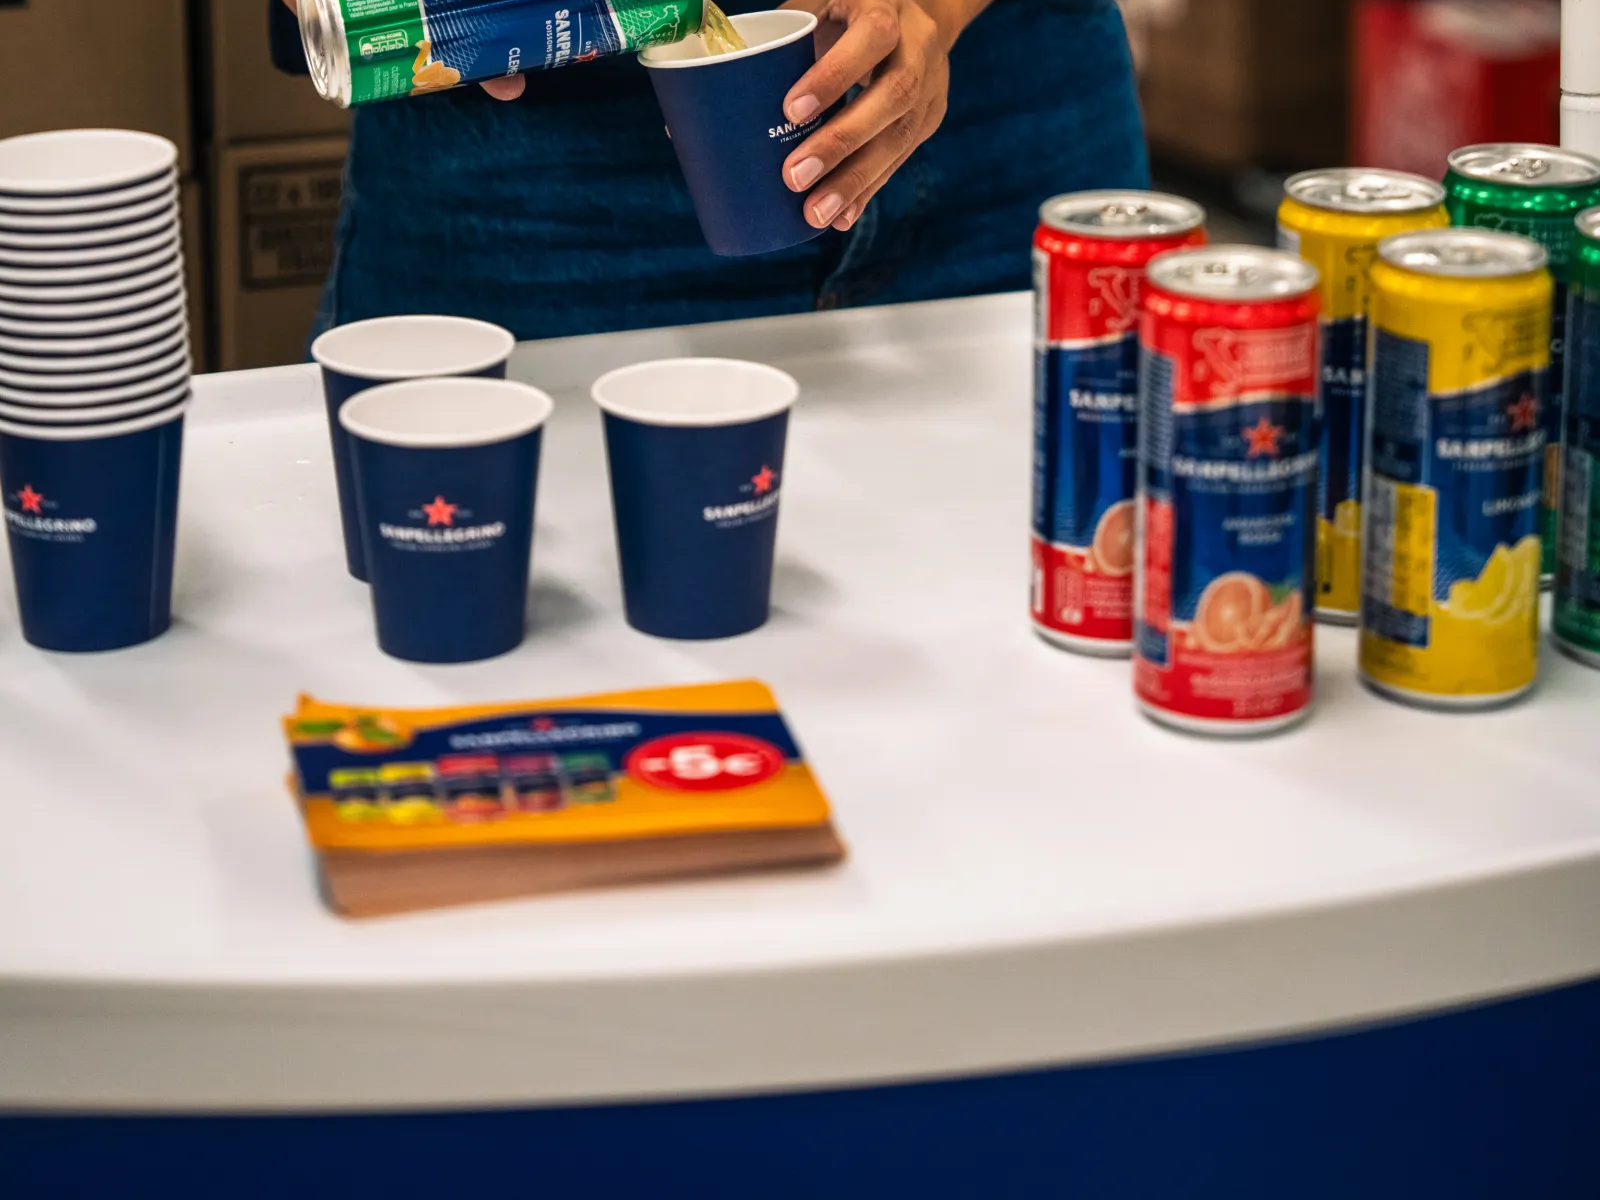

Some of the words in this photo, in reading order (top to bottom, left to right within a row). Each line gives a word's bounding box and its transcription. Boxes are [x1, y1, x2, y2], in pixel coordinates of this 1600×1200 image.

[545, 20, 553, 53] BOISSONS
[780, 132, 801, 143] ITALIAN
[379, 521, 506, 544] SANPELLEGRINO
